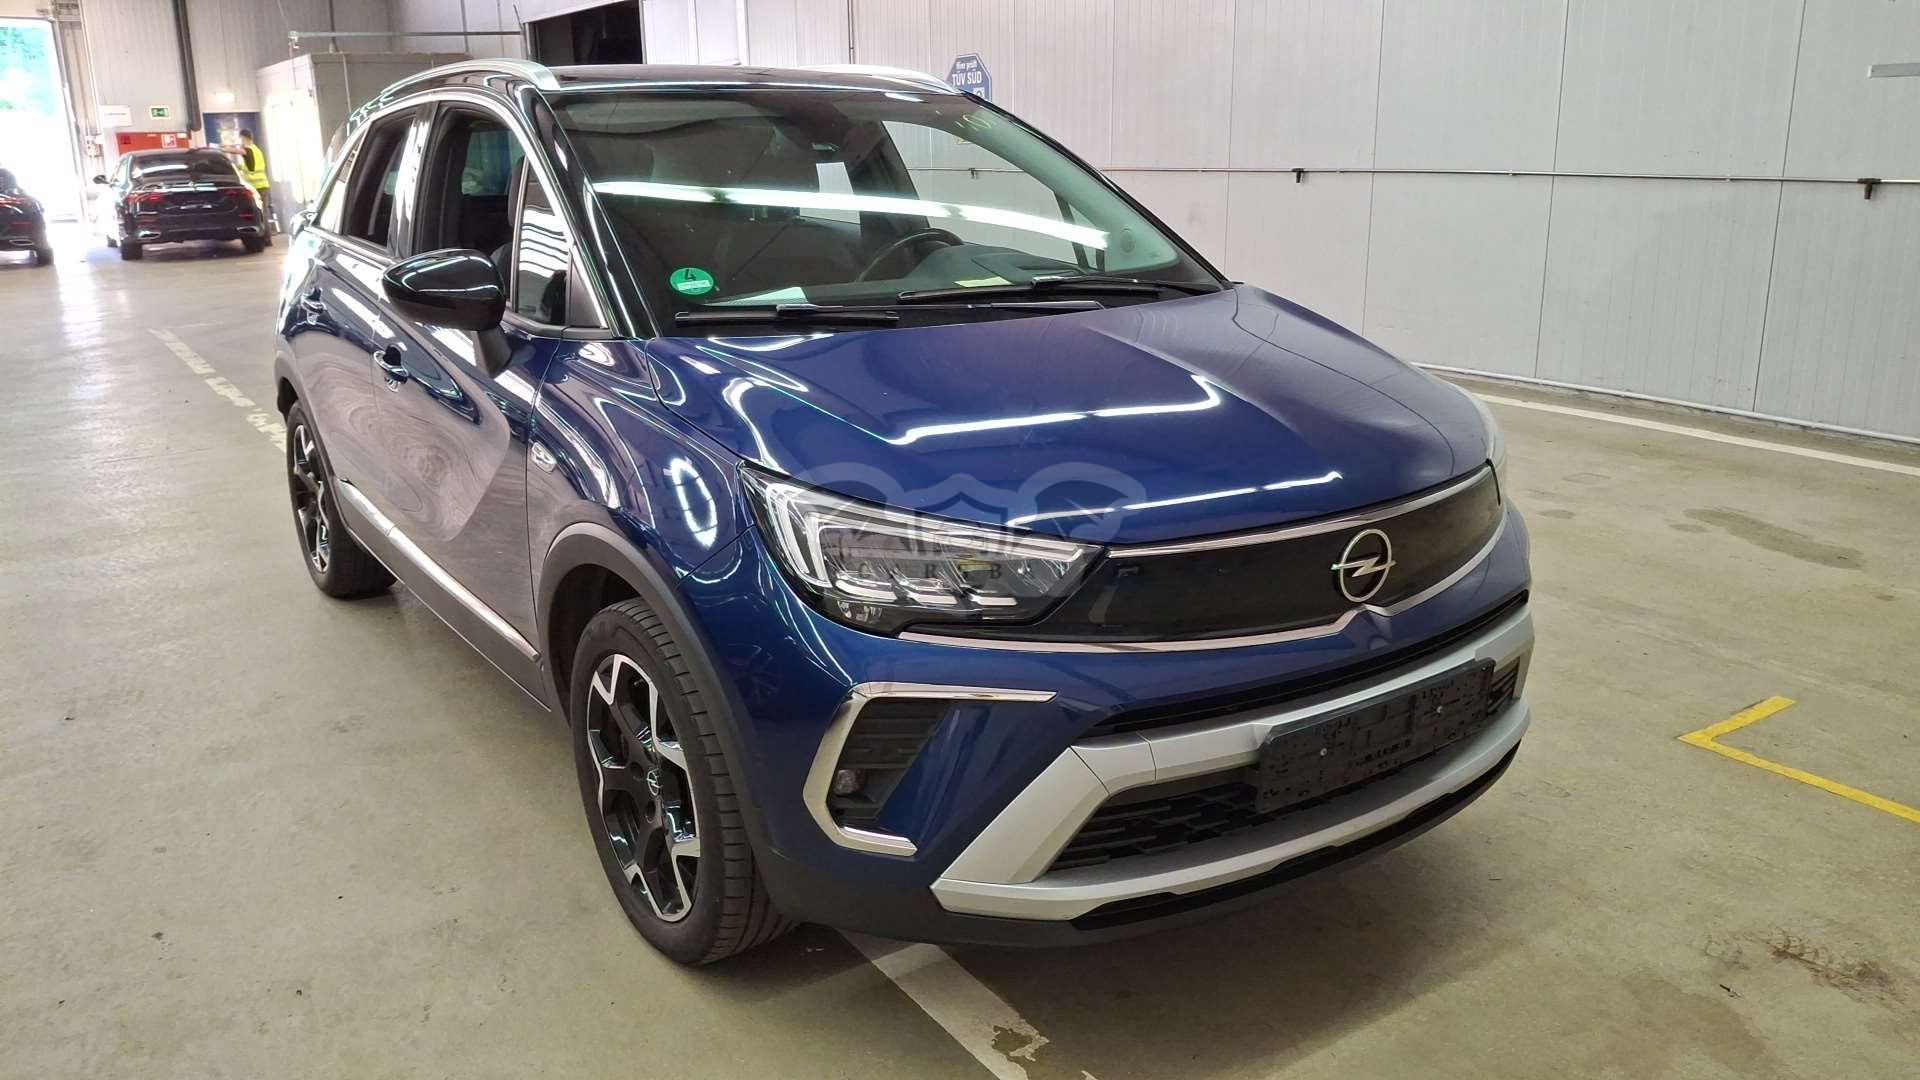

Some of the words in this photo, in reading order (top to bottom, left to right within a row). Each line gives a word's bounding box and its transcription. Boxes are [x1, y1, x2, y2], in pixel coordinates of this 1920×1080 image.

[952, 71, 966, 86] TÜV
[967, 69, 982, 84] SÜD
[685, 269, 697, 280] 4
